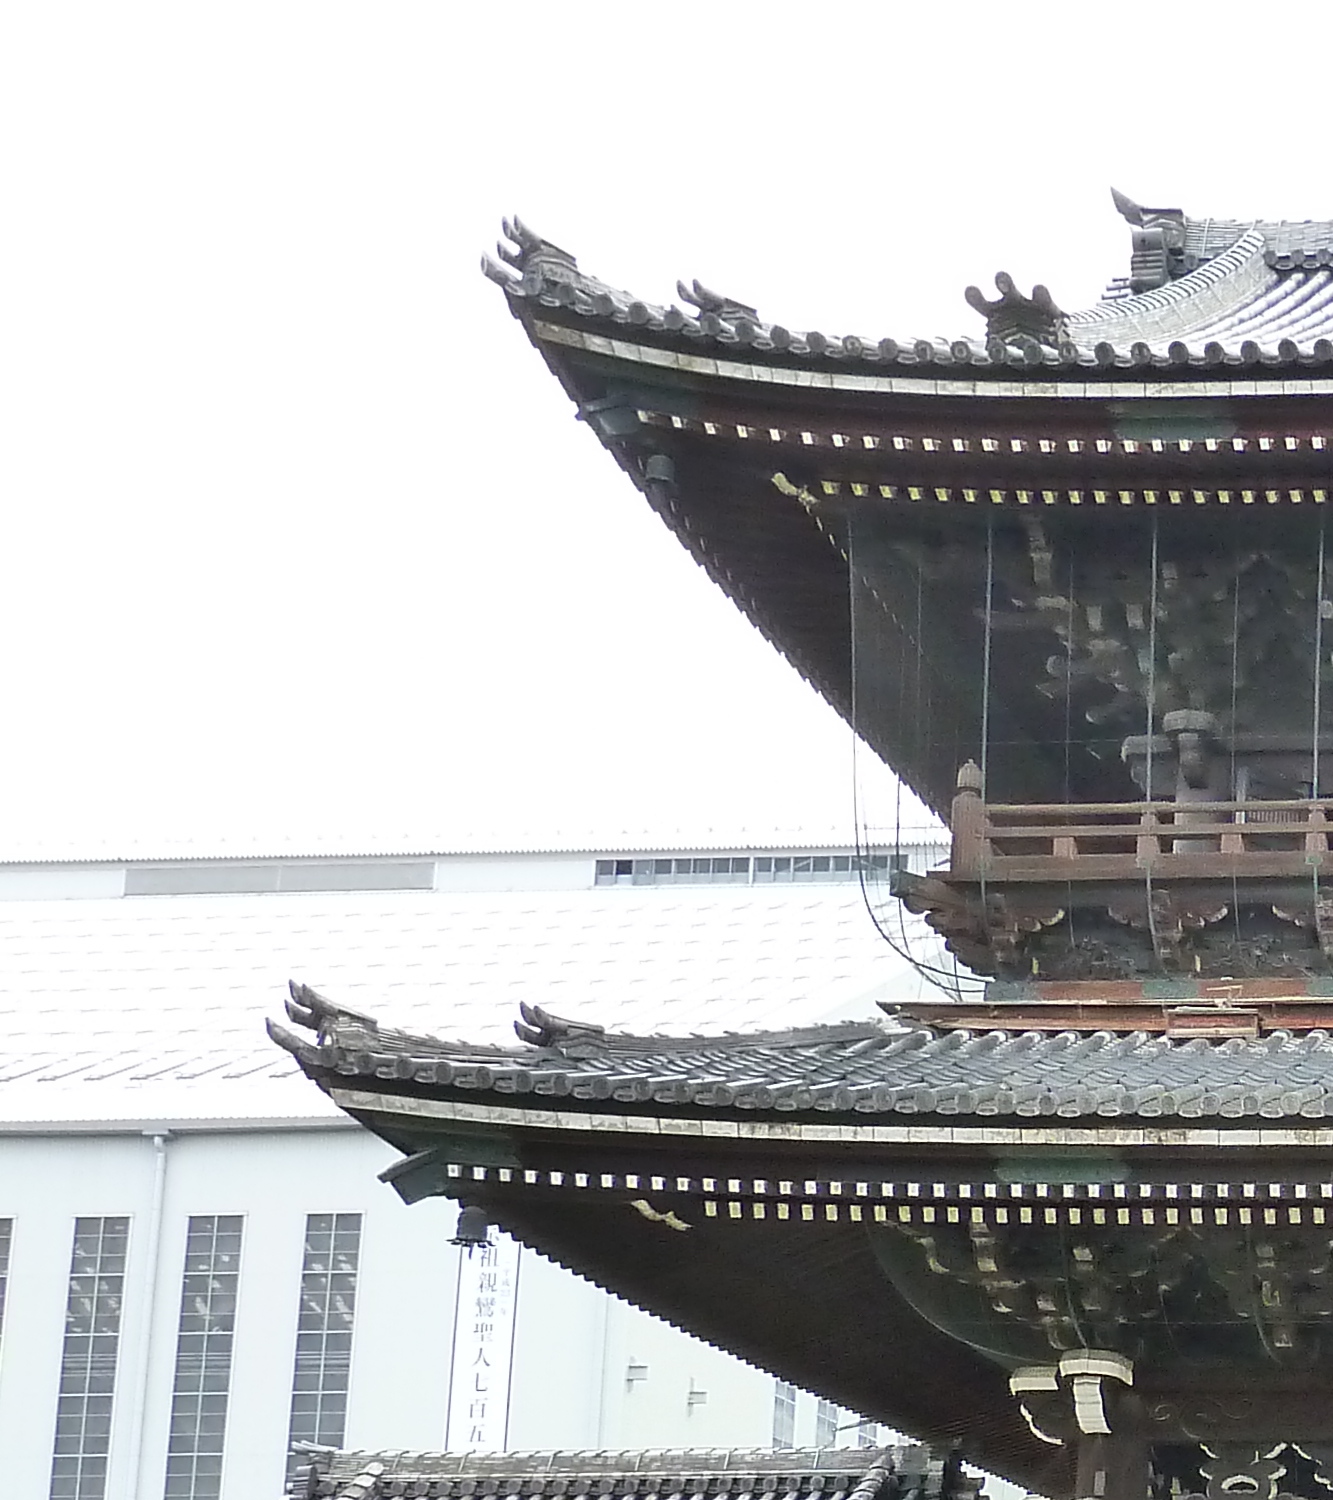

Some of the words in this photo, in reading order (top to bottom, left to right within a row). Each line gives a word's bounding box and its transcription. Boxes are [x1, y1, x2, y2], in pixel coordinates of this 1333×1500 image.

[468, 1226, 500, 1450] 祖親鸞聖人七百五
